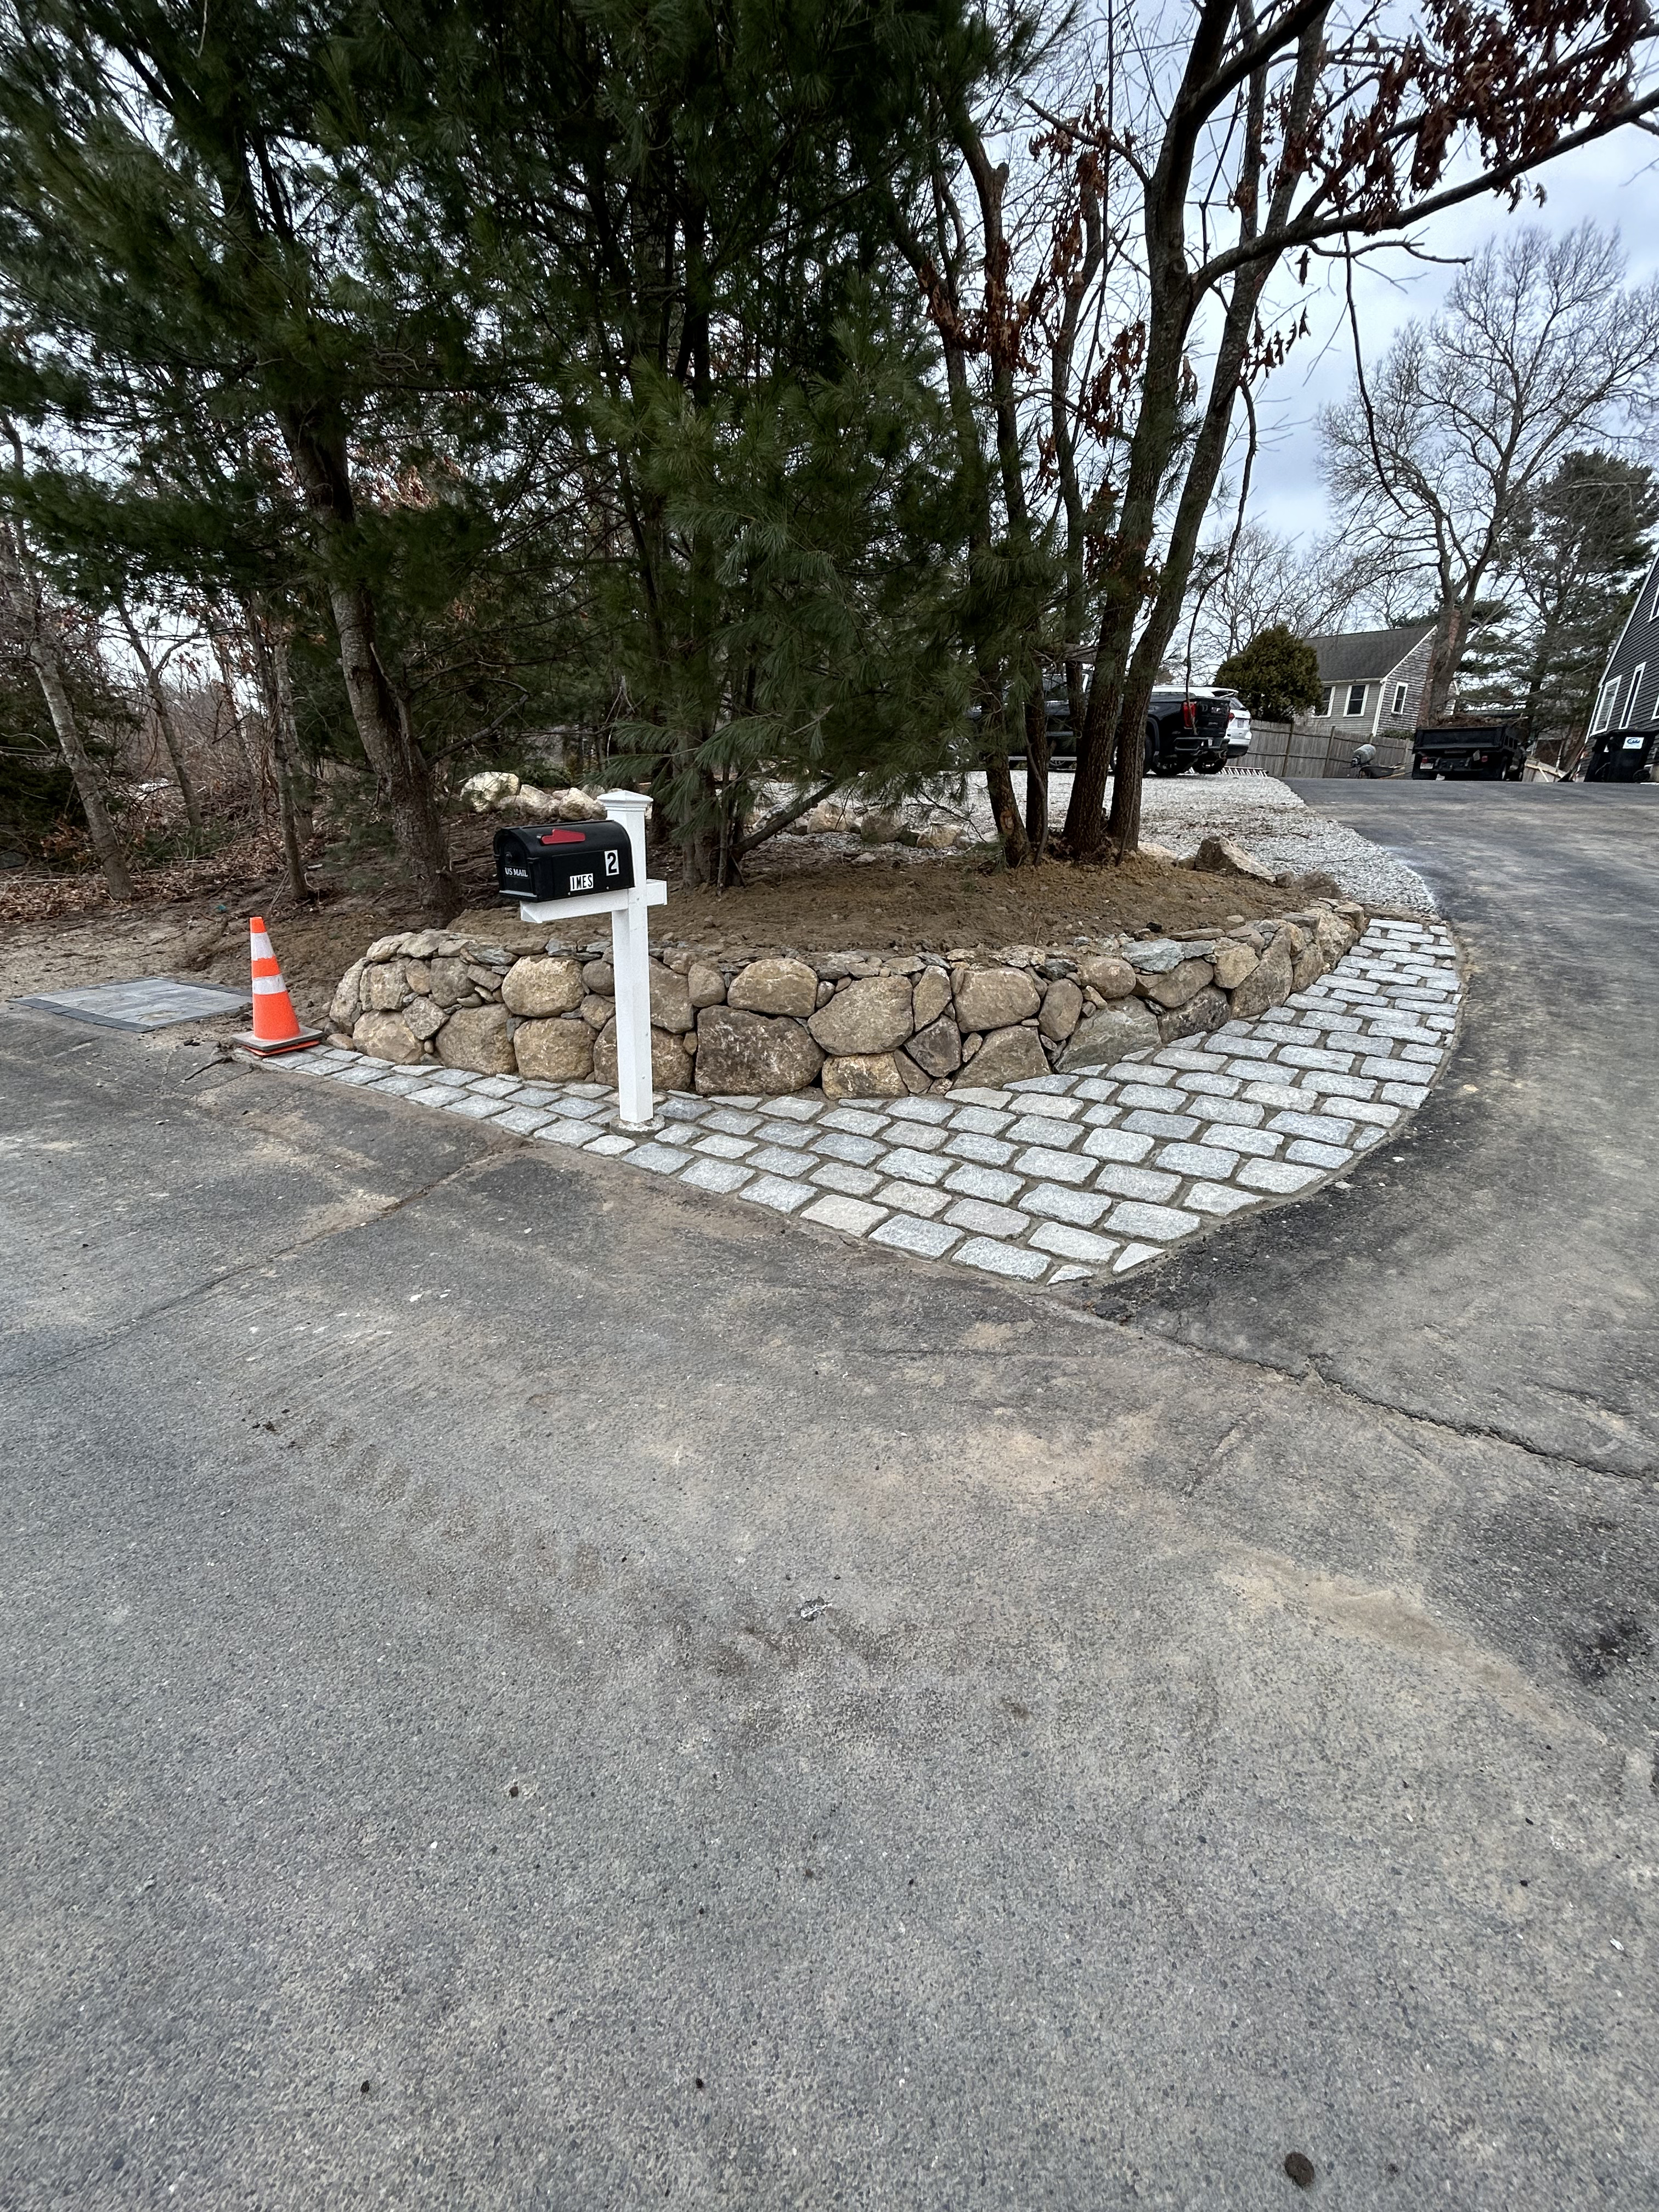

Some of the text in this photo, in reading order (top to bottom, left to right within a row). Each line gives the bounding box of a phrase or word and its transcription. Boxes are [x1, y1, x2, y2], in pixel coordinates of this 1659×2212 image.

[607, 852, 617, 874] 2
[505, 867, 528, 877] US MAIL
[572, 874, 592, 889] IMES
